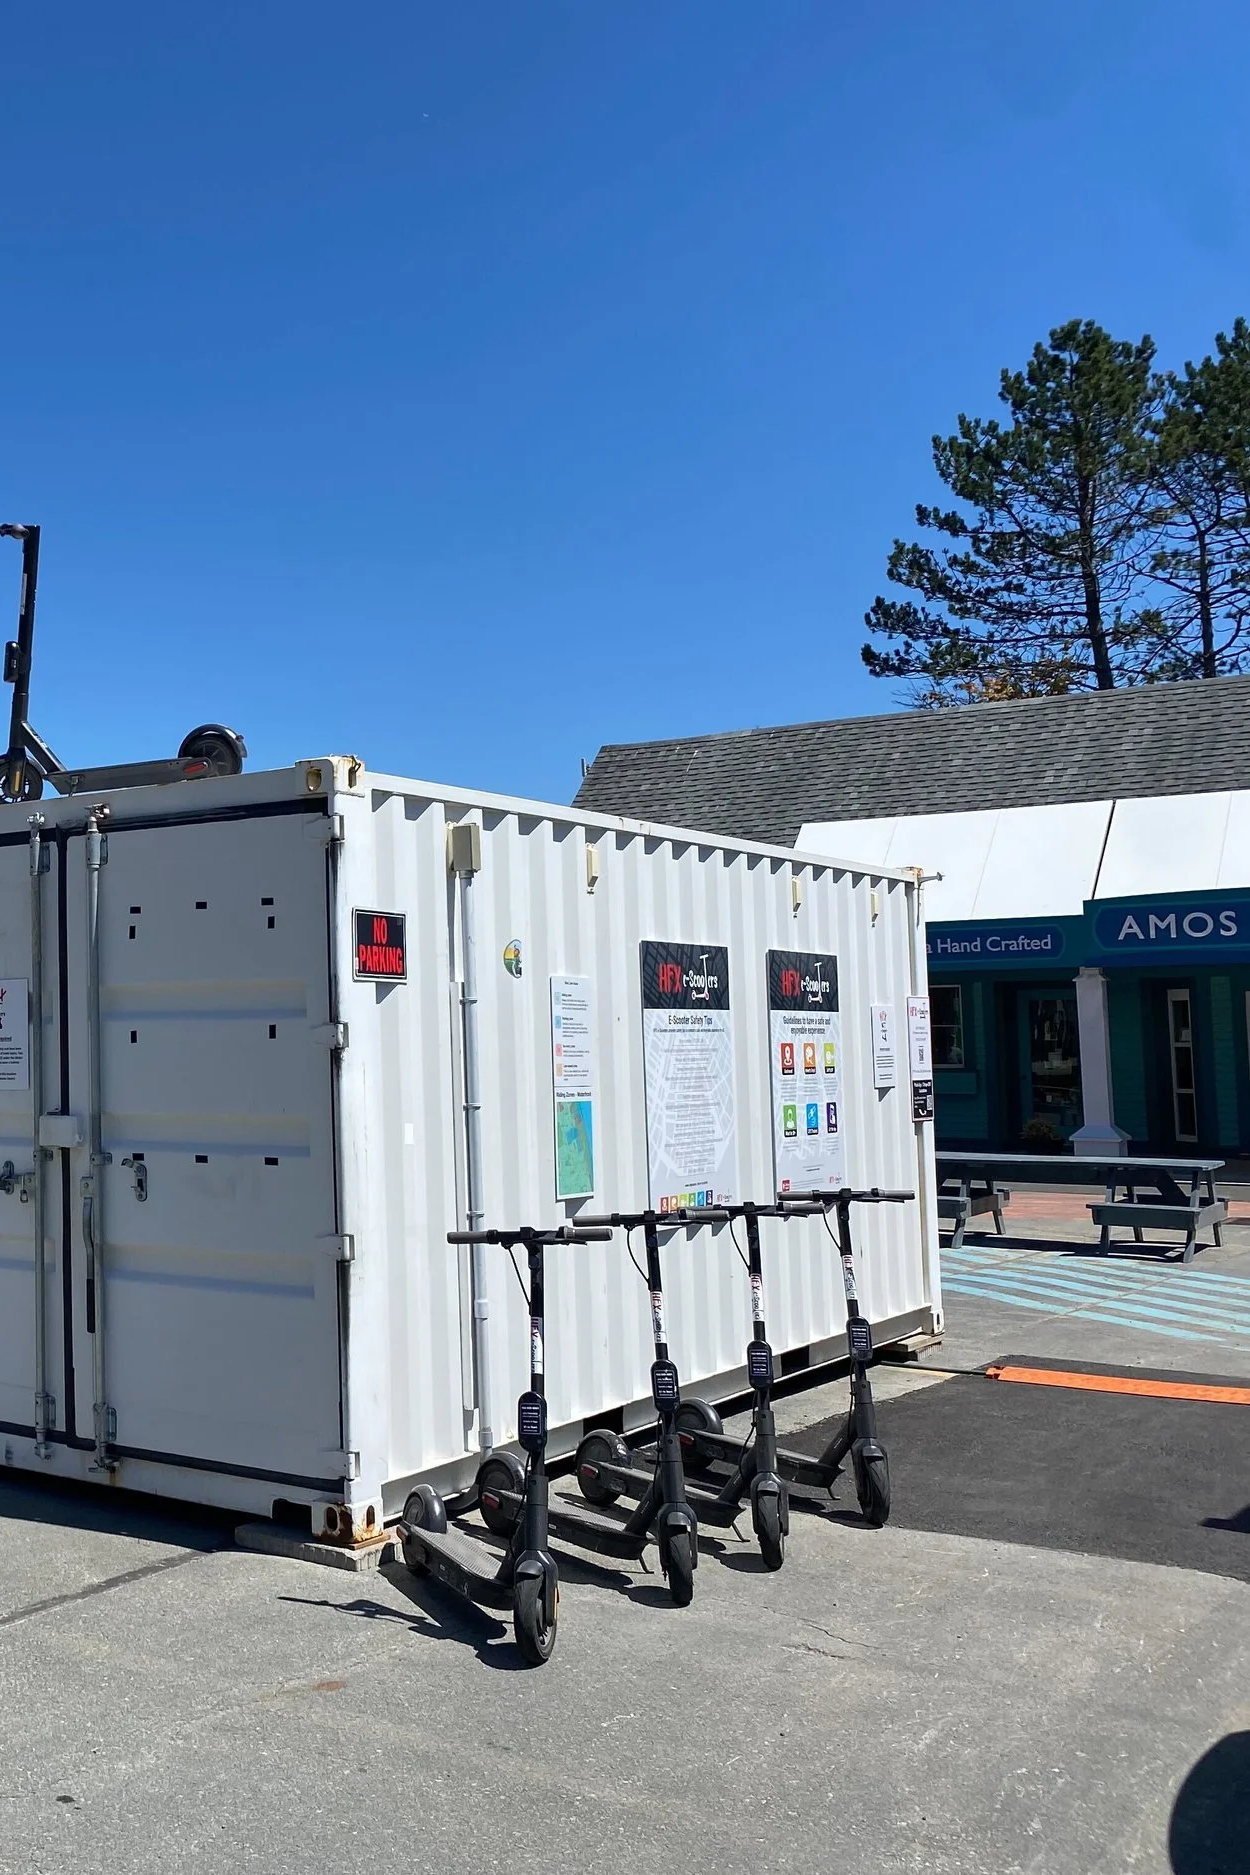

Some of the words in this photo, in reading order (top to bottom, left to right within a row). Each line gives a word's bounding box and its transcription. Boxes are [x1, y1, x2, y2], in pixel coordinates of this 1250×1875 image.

[373, 917, 388, 944] NO
[1118, 911, 1238, 940] AMOS
[937, 937, 981, 953] Hand
[986, 935, 1051, 951] Crafted
[358, 944, 403, 974] PARKING
[658, 963, 682, 992] HFX
[782, 969, 800, 996] HFX
[669, 1015, 690, 1025] E-Scooter
[691, 1015, 703, 1027] Safety
[704, 1015, 713, 1025] Tips
[783, 1016, 802, 1025] Guidelines
[751, 1274, 760, 1291] HFX
